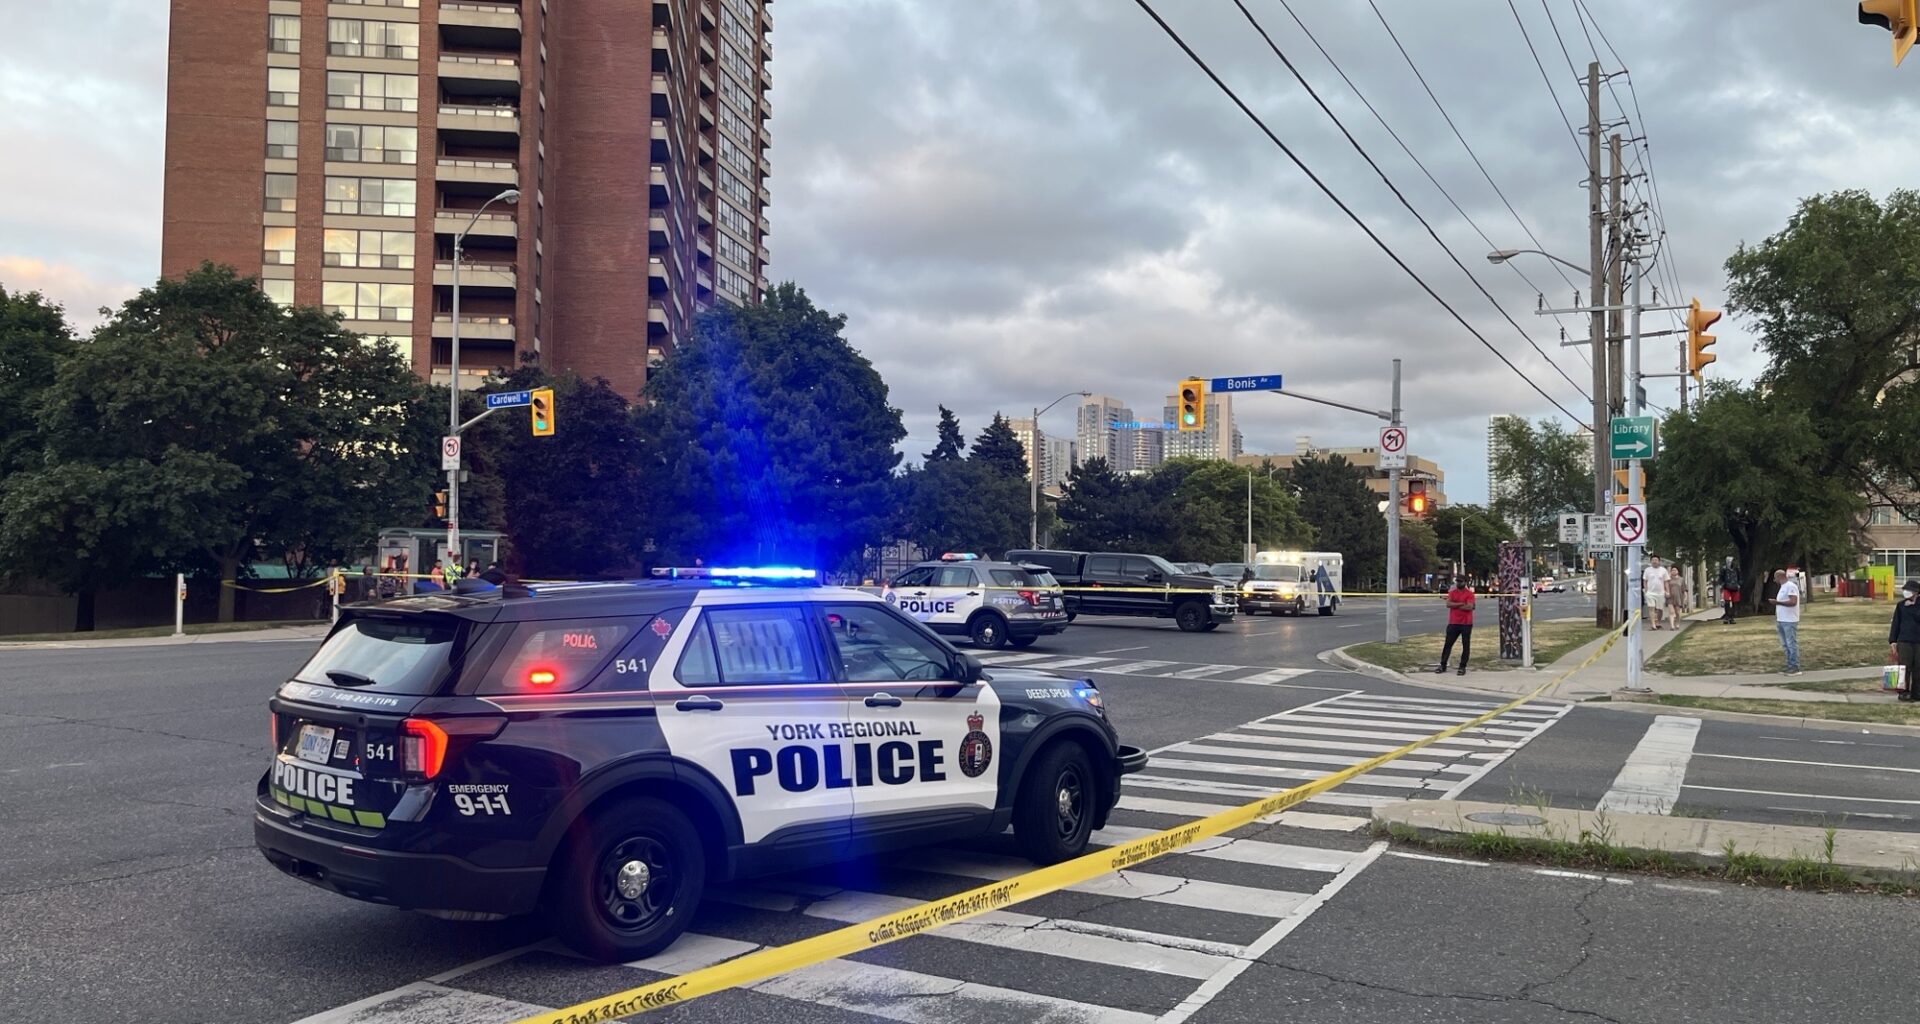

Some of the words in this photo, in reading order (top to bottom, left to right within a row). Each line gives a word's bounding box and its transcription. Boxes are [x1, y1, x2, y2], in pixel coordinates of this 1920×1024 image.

[1227, 378, 1256, 389] Bonis
[491, 393, 521, 404] Cardwell
[1614, 425, 1650, 435] Library
[900, 601, 955, 613] POLICE
[563, 634, 597, 648] POLIC
[616, 658, 648, 673] 541
[1025, 688, 1050, 699] DEEDS
[766, 723, 824, 740] YORK
[828, 721, 921, 738] REGIONAL
[366, 743, 395, 761] 541
[730, 740, 946, 796] POLICE
[274, 759, 354, 805] POLICE
[449, 784, 509, 793] EMERGENCY
[454, 794, 512, 816] 9-1-1
[869, 928, 895, 943] Crime
[896, 916, 932, 935] Stoppers
